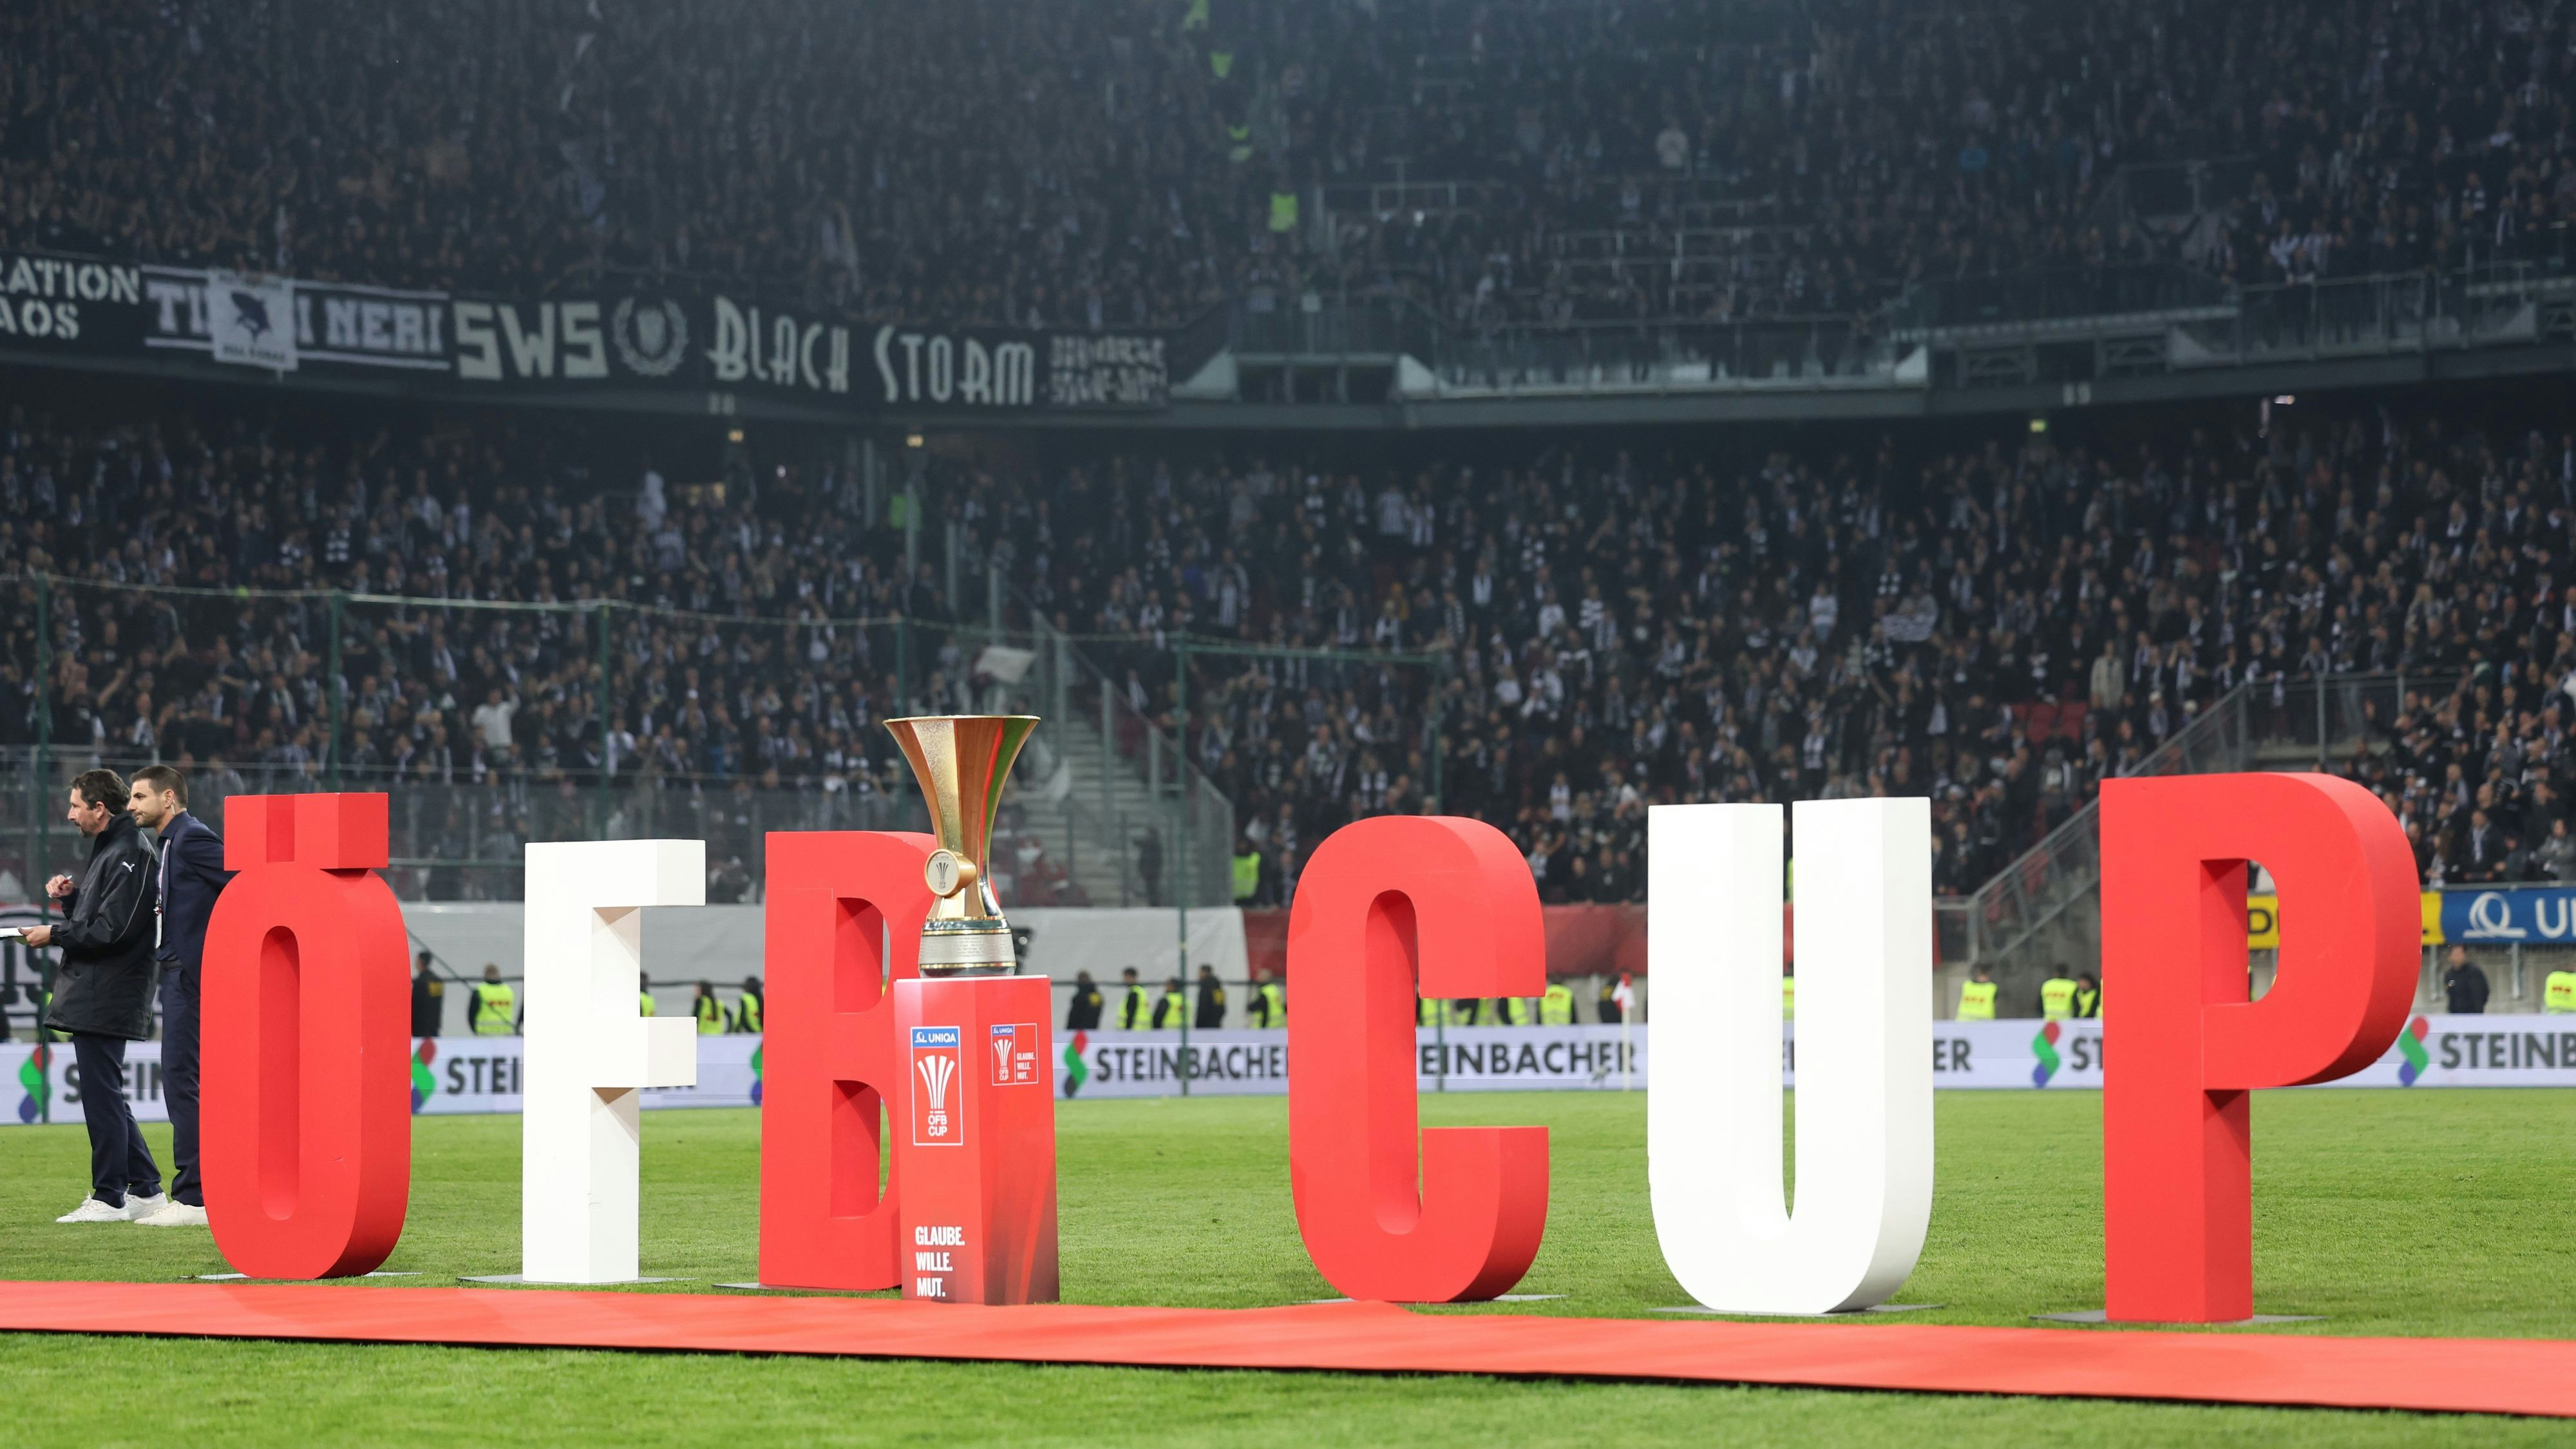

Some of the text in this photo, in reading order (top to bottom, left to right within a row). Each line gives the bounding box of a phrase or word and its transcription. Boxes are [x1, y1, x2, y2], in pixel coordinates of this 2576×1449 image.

[0, 256, 140, 305] ATION
[454, 301, 609, 380] SWS
[875, 325, 1034, 405] STORM
[2535, 896, 2576, 938] U
[928, 1032, 956, 1043] UNIQA
[1287, 772, 2422, 1322] CUP
[2439, 1032, 2576, 1069] STEINB
[1017, 1052, 1036, 1061] GLAUBE.
[1096, 1046, 1288, 1081] STEINBACHE
[928, 1126, 947, 1137] CUP
[915, 1226, 965, 1245] GLAUBE.
[915, 1252, 953, 1271] WILLE.
[916, 1277, 946, 1297] MUT.
